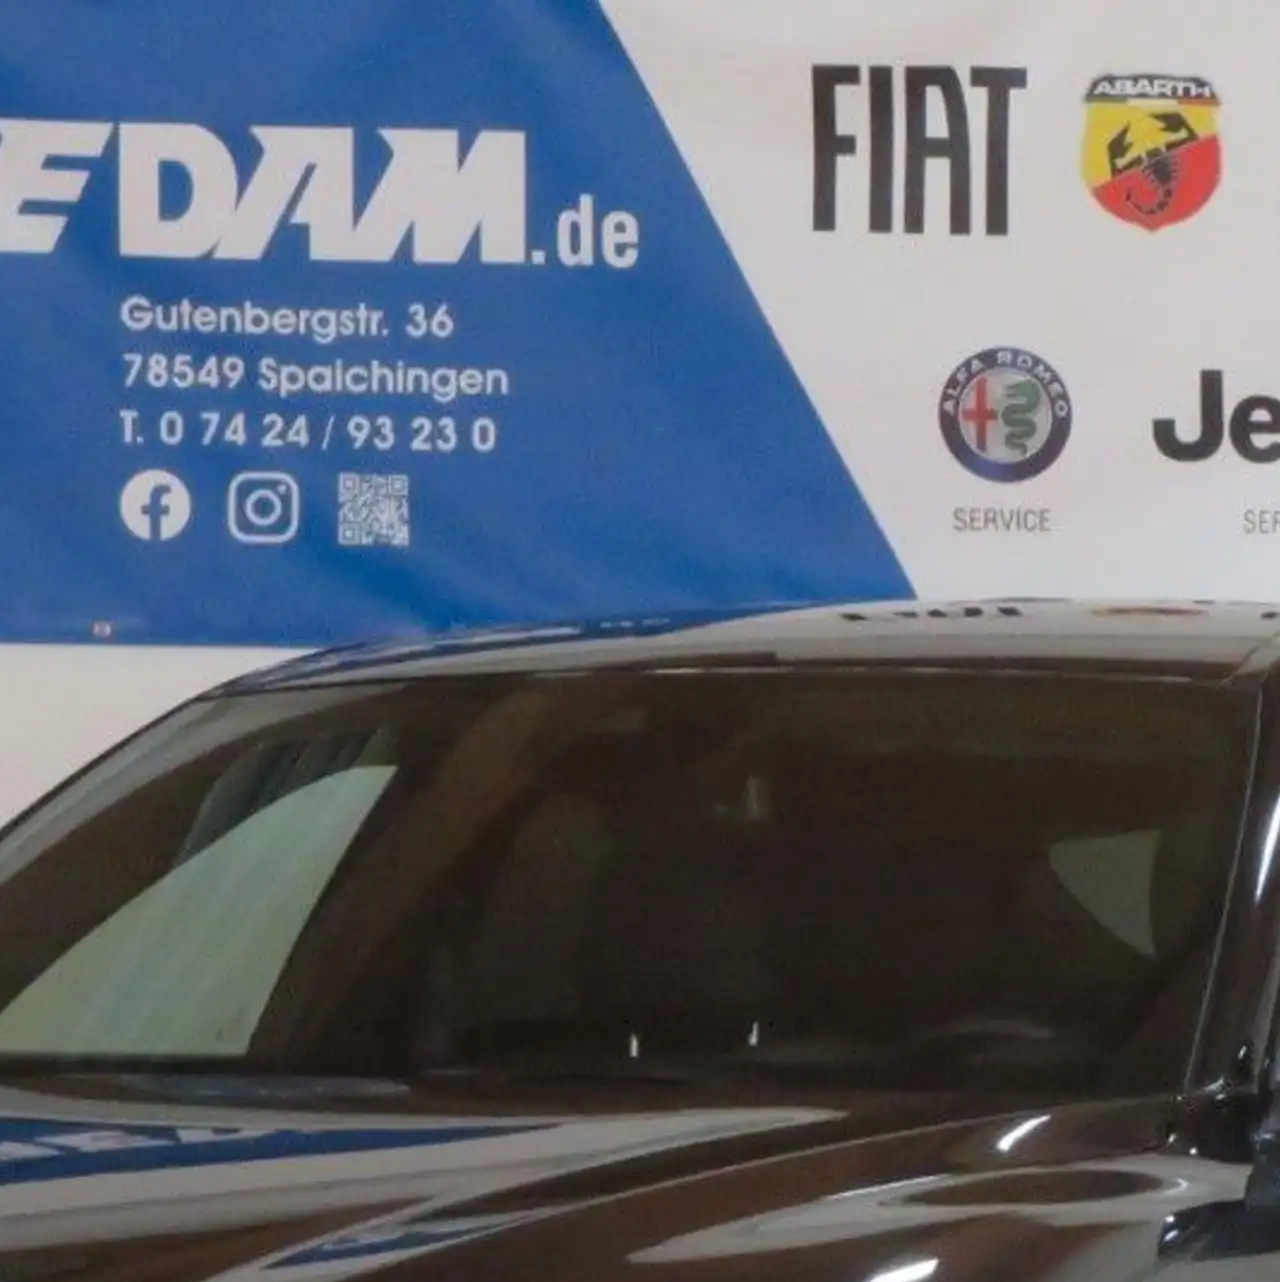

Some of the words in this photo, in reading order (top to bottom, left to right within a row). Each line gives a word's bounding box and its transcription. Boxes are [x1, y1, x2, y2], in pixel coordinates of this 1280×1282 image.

[1093, 78, 1213, 98] ABARTH
[811, 64, 1027, 236] FIAT
[120, 295, 390, 344] Gutenbergstr.
[405, 304, 455, 338] 36
[122, 353, 245, 390] 78549
[257, 357, 510, 402] Spaichingen
[942, 358, 986, 417] ALFA
[996, 350, 1068, 419] ROMEO
[118, 411, 144, 446] T.
[159, 410, 184, 446] 0
[200, 412, 247, 447] 74
[261, 412, 311, 448] 24
[347, 416, 396, 451] 93
[410, 417, 457, 452] 23
[471, 418, 498, 453] 0
[952, 508, 1052, 533] SERVICE
